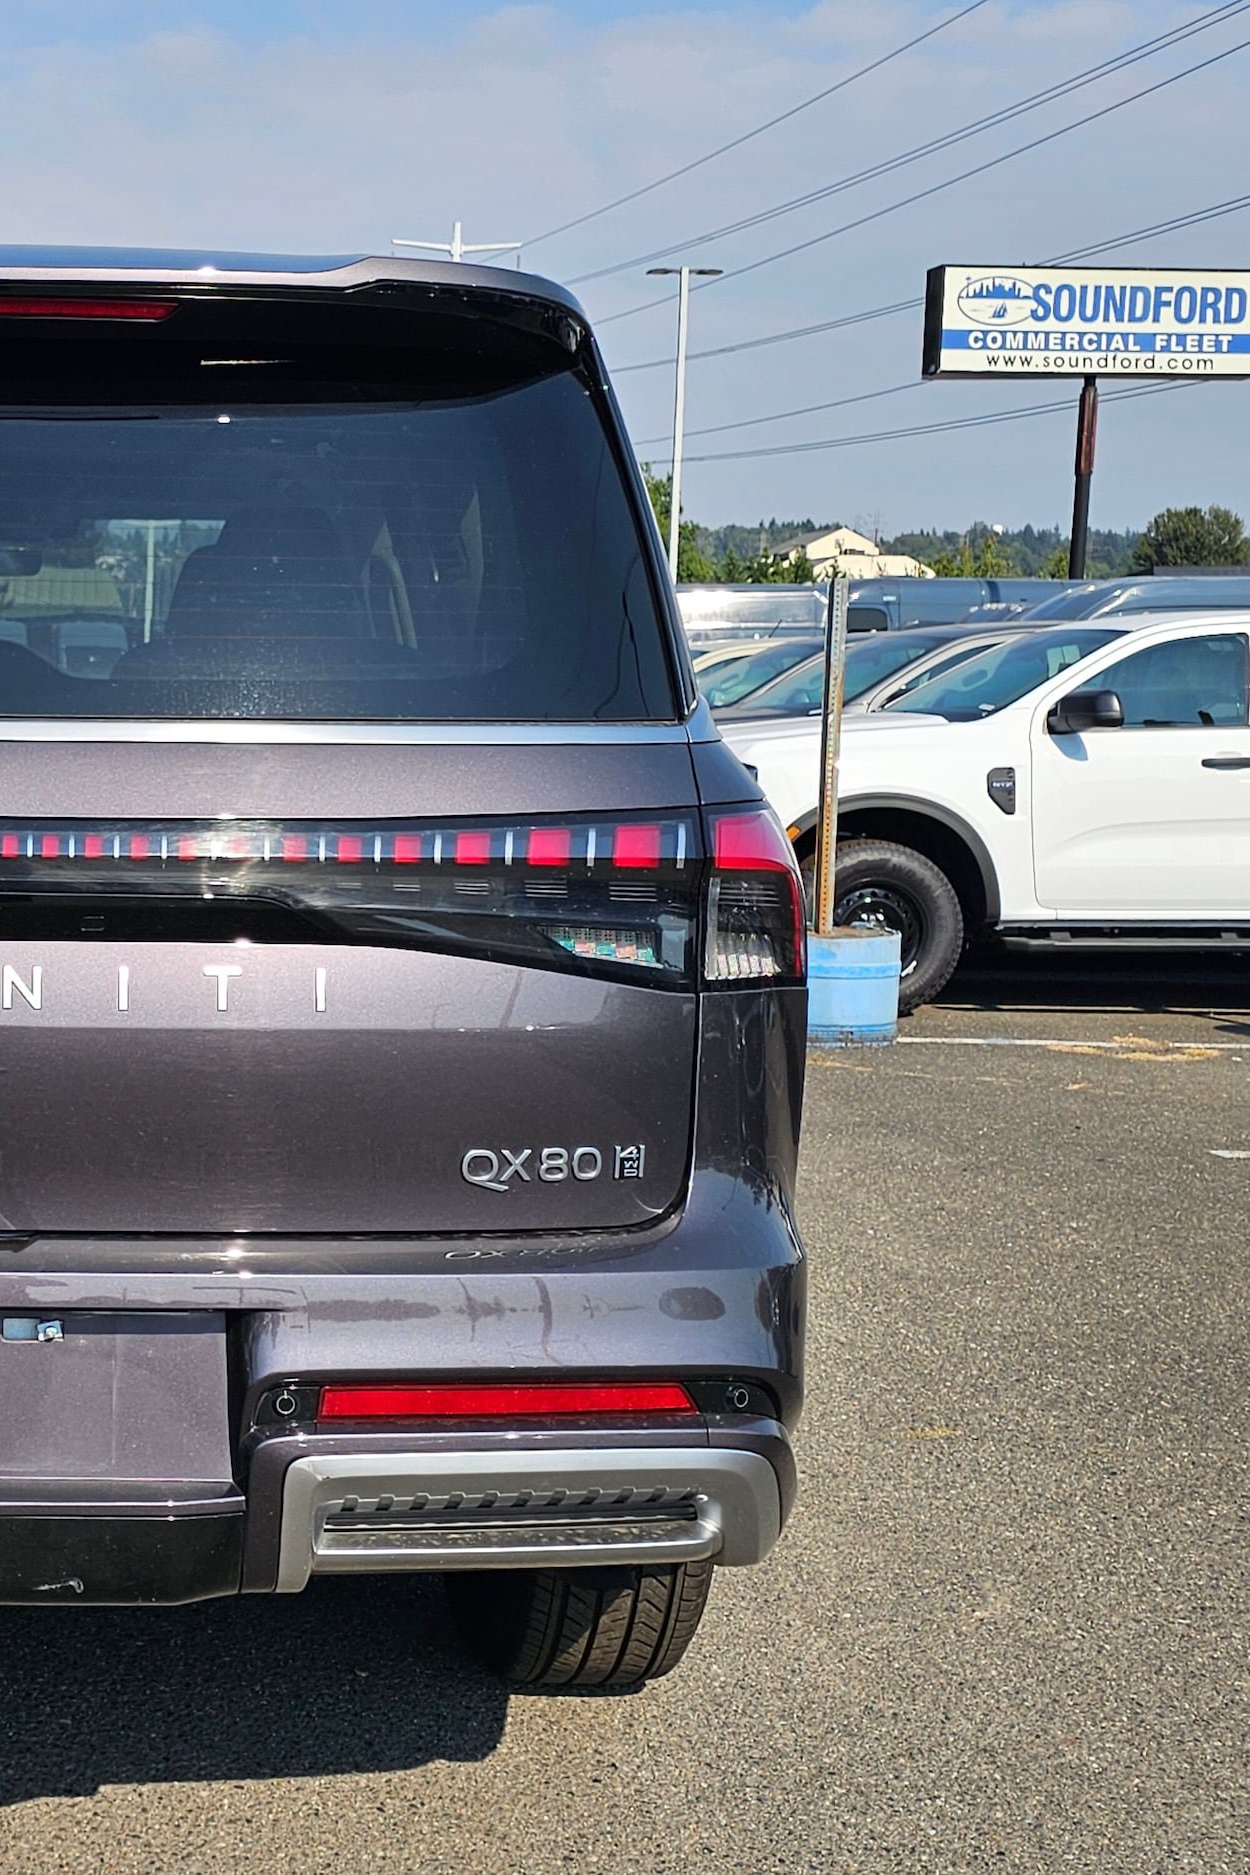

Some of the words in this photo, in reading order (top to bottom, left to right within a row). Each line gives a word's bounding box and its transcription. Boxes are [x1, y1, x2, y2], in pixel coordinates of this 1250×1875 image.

[1030, 283, 1247, 324] SOUNDFORD
[968, 331, 1141, 351] COMMERCIAL
[1155, 334, 1233, 352] FLEET
[986, 353, 1214, 371] www.soundford.com
[461, 1147, 602, 1192] QX80
